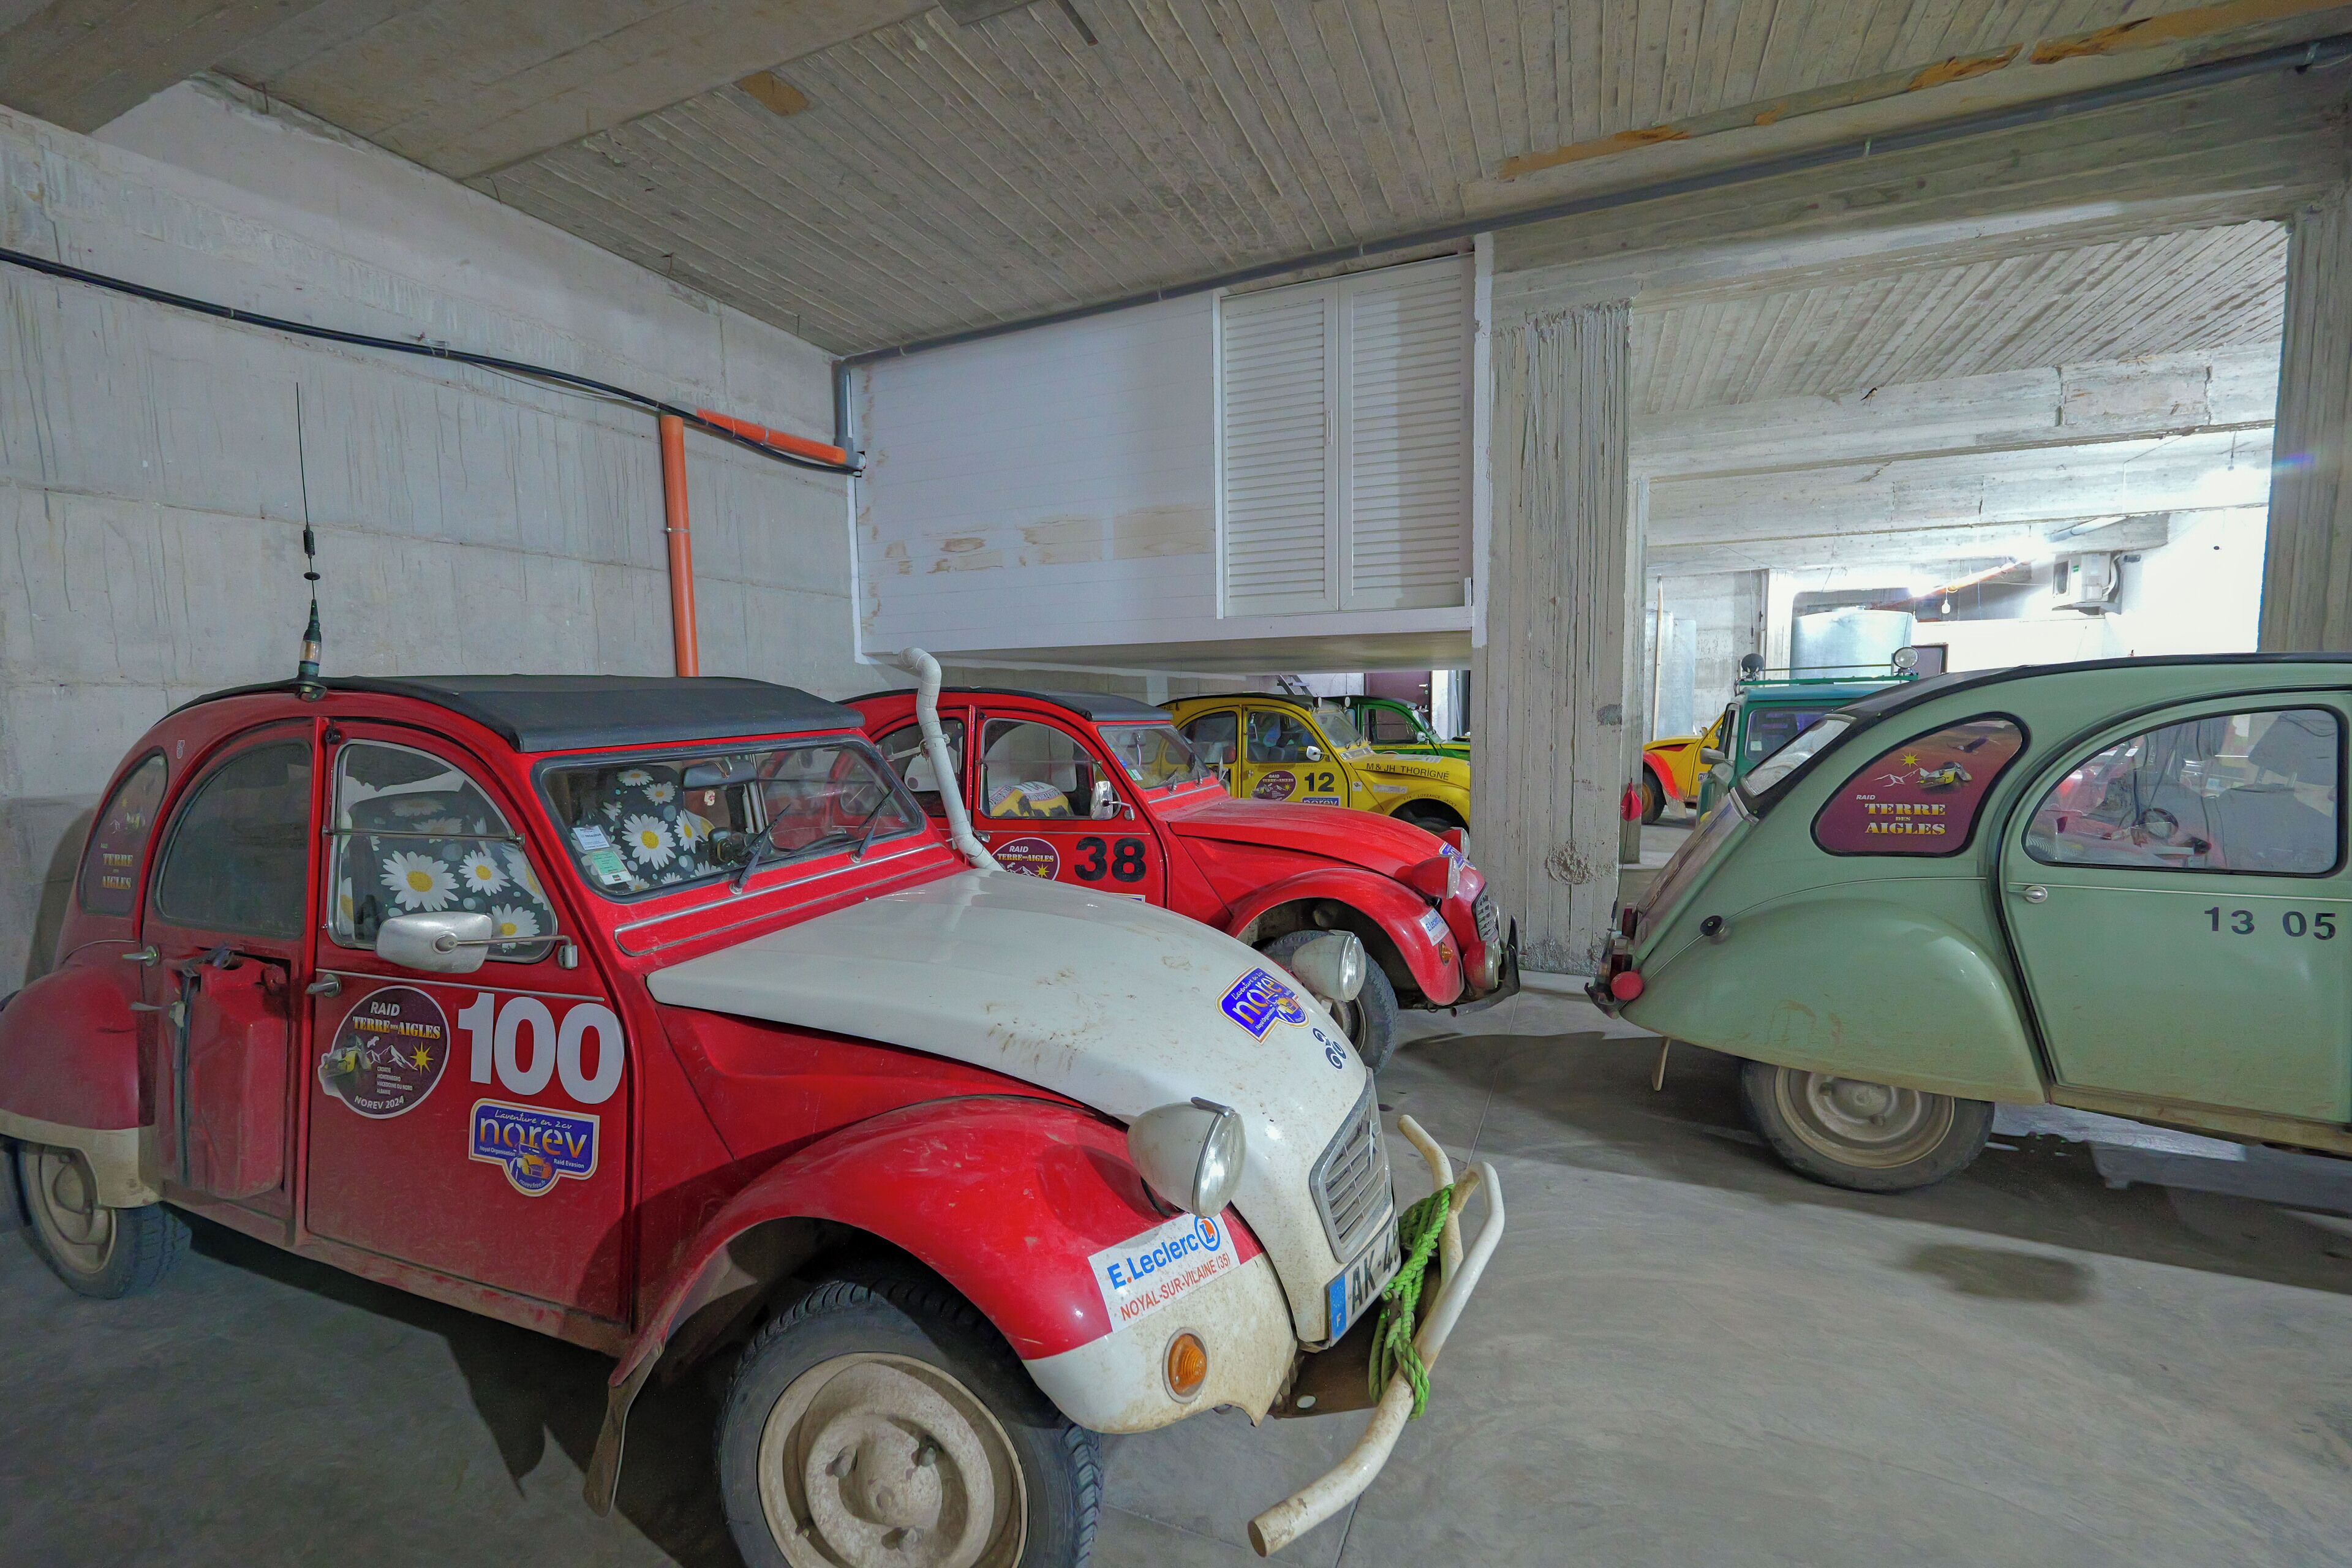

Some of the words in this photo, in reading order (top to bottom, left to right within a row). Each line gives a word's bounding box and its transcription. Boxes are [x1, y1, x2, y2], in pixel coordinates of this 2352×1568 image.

[1305, 772, 1334, 792] 12
[1865, 804, 1945, 815] TERRE
[1865, 822, 1946, 835] AIGLES
[103, 853, 133, 867] TERRE
[1074, 837, 1146, 882] 38
[102, 876, 132, 889] AIGLES
[2204, 907, 2255, 935] 13
[2283, 911, 2336, 940] 05
[371, 1001, 400, 1016] RAID
[353, 1016, 390, 1033] TERRE
[398, 1022, 440, 1039] AIGLES
[458, 992, 624, 1104] 100
[355, 1096, 383, 1109] NOREV
[385, 1095, 404, 1109] 2024
[495, 1109, 537, 1123] L'aventure
[480, 1118, 587, 1158] norev
[565, 1160, 584, 1169] Evasion
[1107, 1233, 1199, 1290] E.Leclerc
[1120, 1259, 1216, 1321] NOYAL-SUR-VILAINE
[1216, 1252, 1231, 1271] (35)
[1336, 1313, 1341, 1327] F
